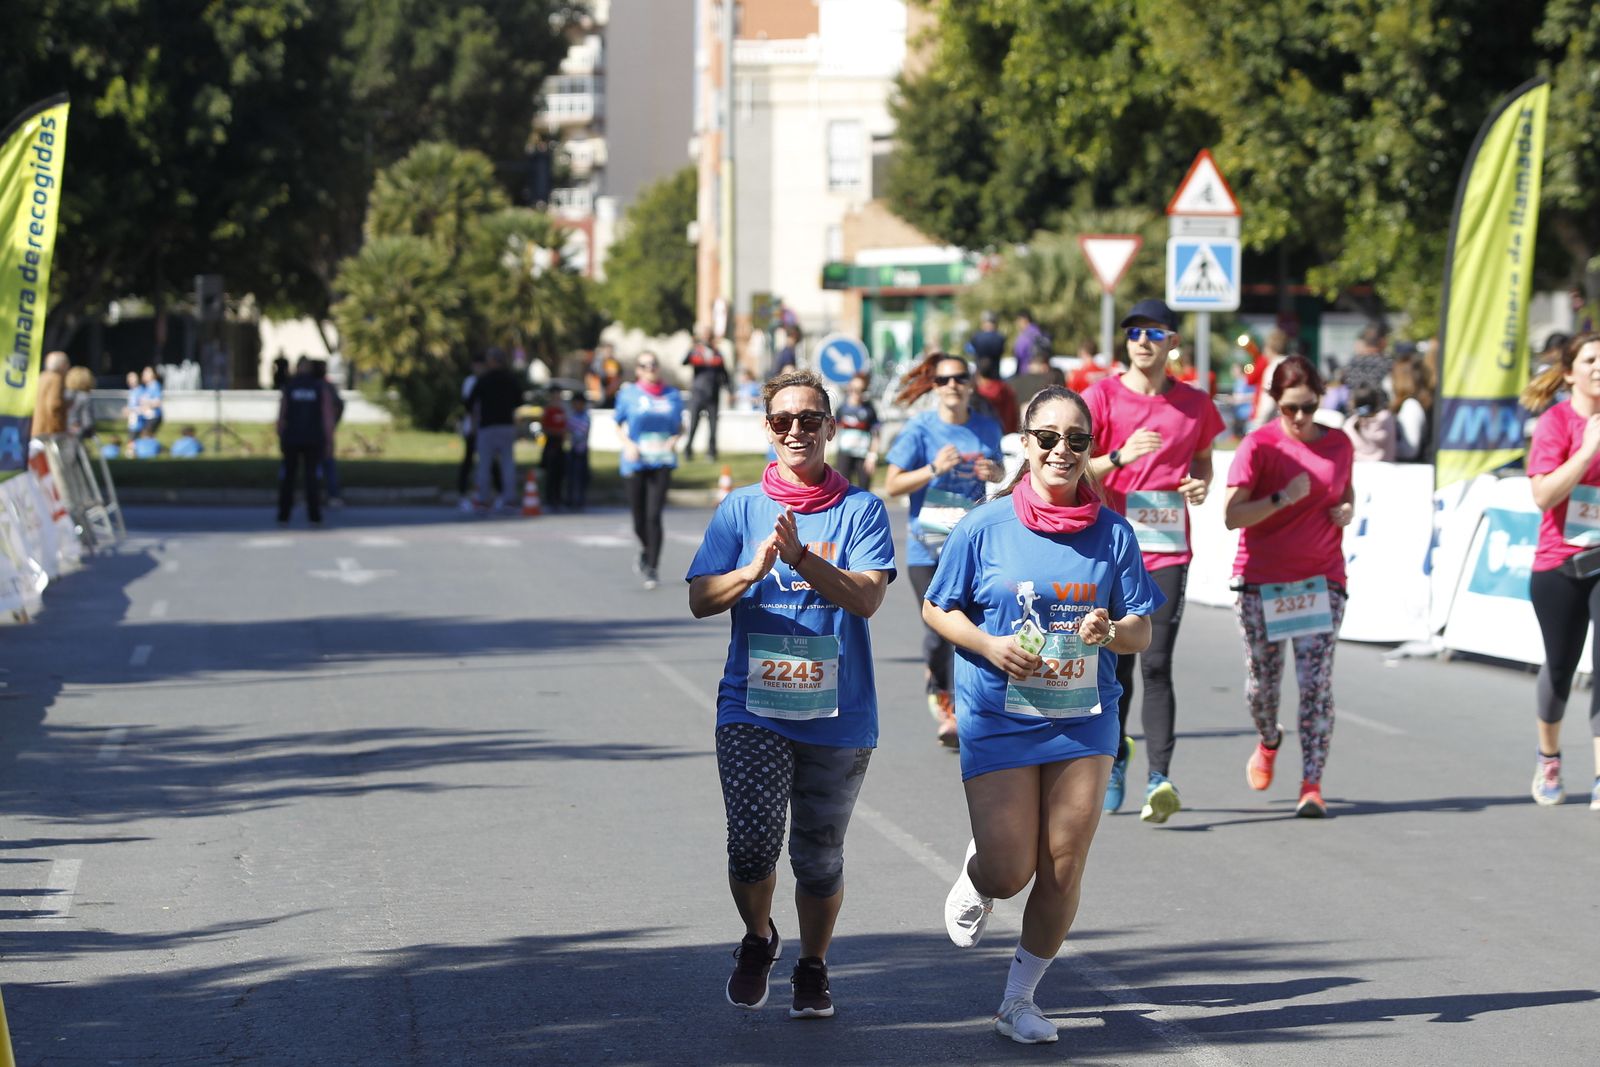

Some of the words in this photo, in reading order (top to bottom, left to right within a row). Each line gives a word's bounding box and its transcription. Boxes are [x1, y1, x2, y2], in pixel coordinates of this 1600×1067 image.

[5, 288, 37, 389] Cámara
[1138, 508, 1179, 524] 2325
[1052, 582, 1097, 602] VIII
[1050, 604, 1095, 613] CARRERA
[1274, 593, 1317, 614] 2327
[762, 660, 824, 682] 2245
